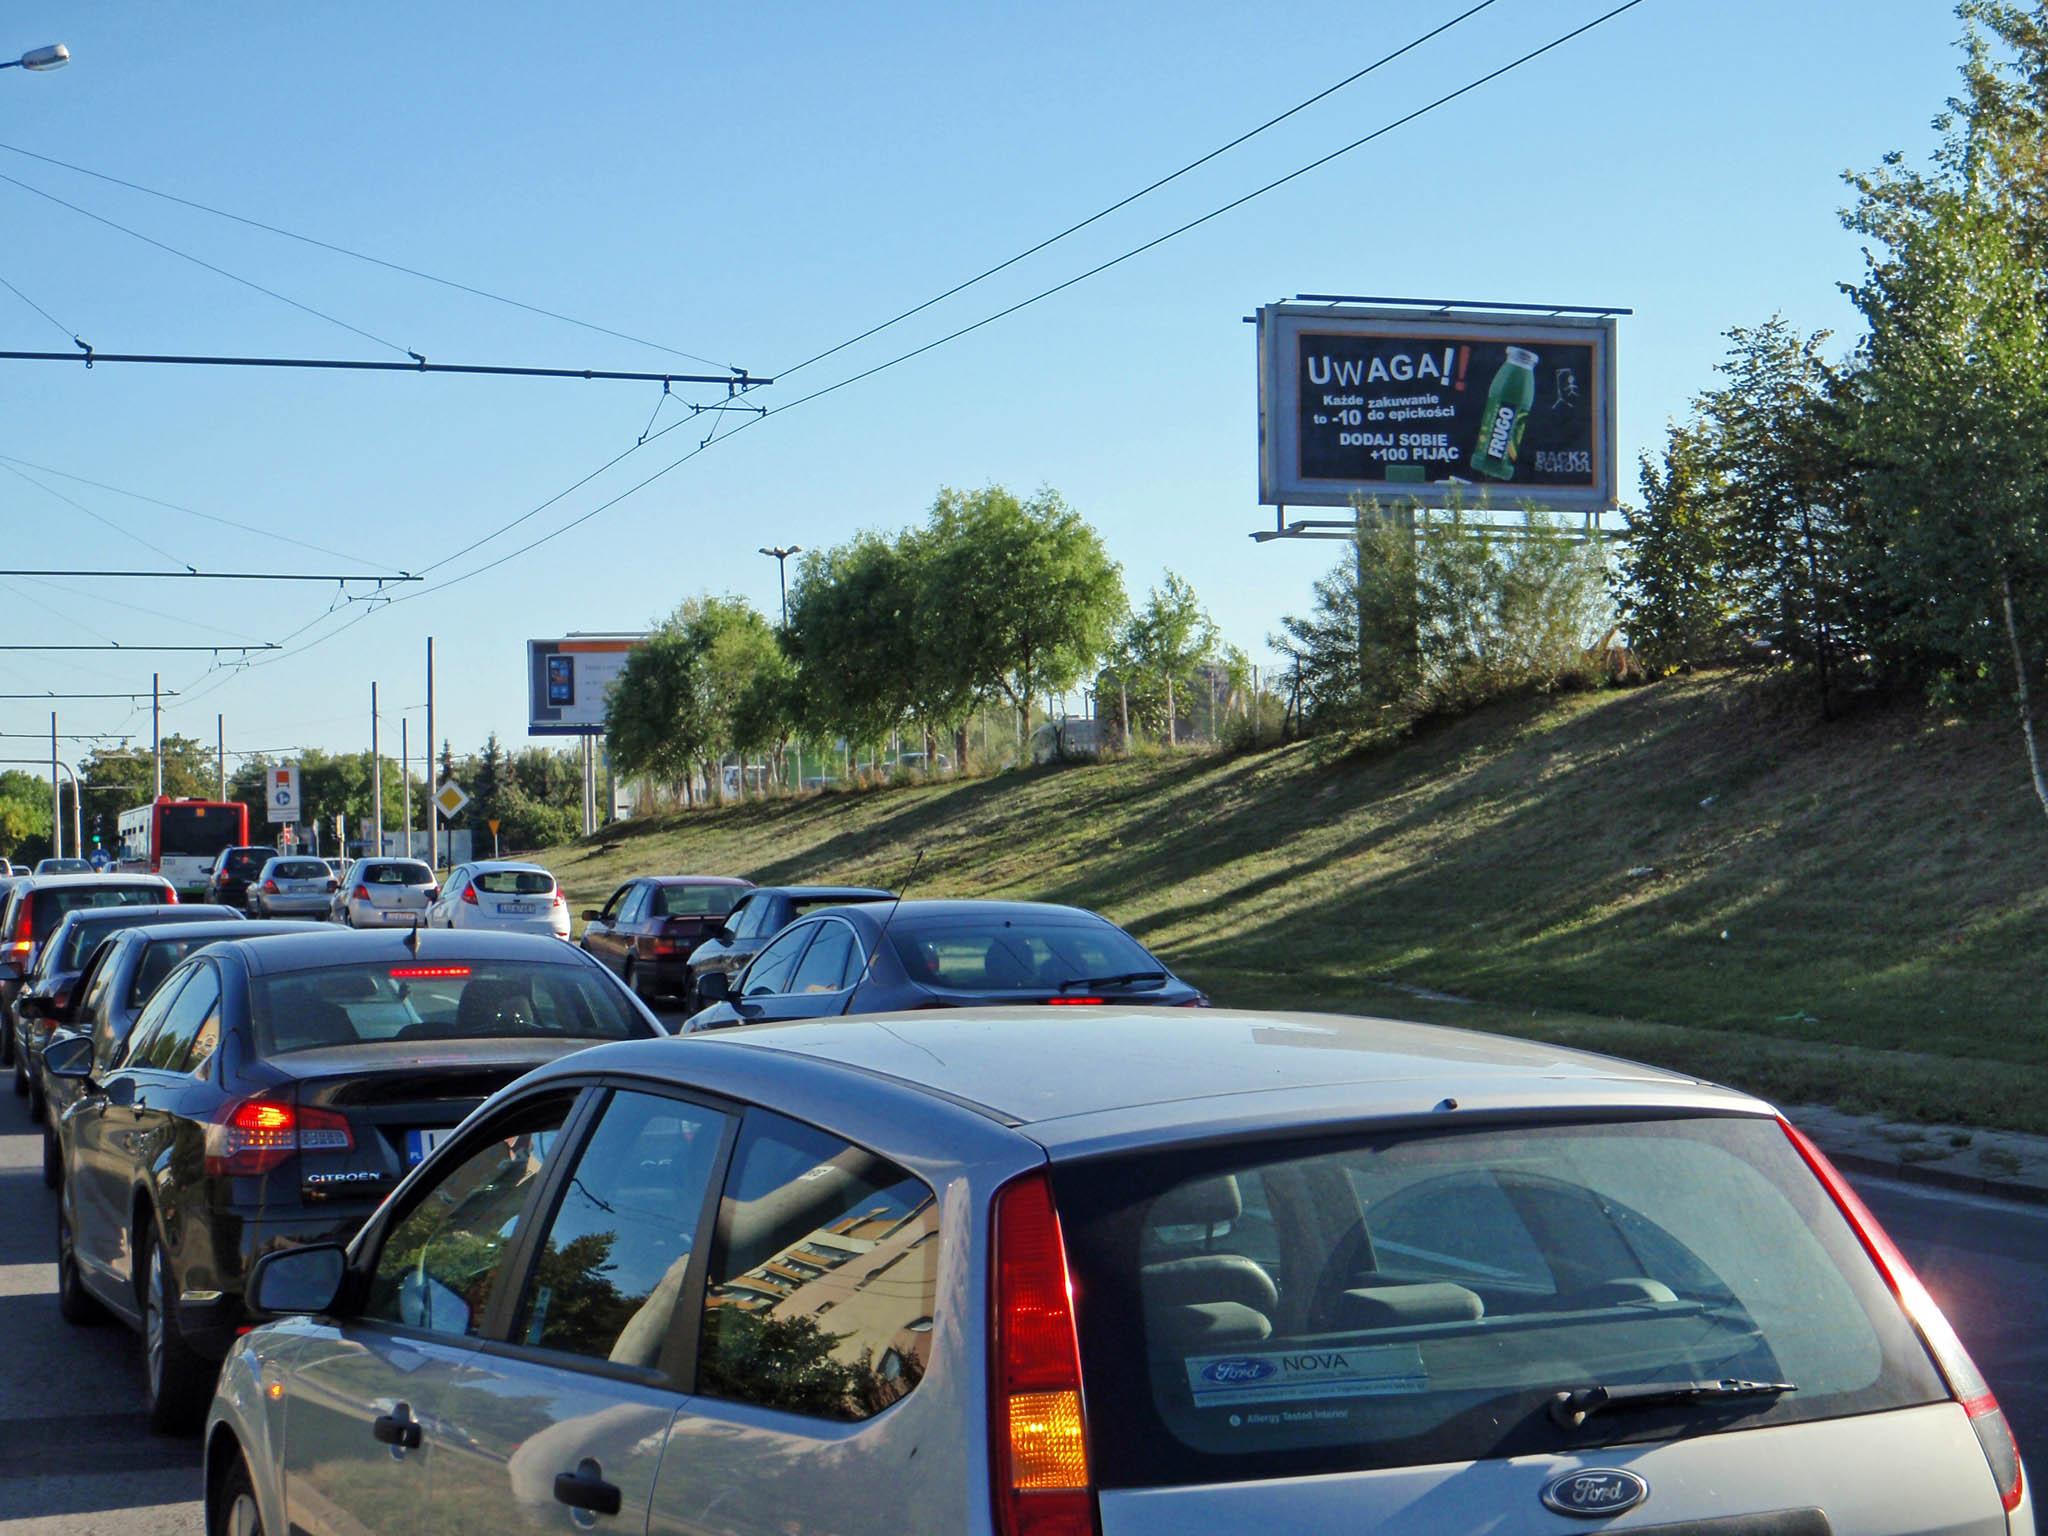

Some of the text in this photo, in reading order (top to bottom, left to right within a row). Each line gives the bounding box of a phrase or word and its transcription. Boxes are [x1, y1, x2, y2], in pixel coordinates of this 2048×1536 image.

[1323, 393, 1440, 409] Każde zakuwanie
[1313, 405, 1455, 426] to -10 do epickości
[1339, 432, 1448, 447] DODAJ SOBIE
[1487, 406, 1515, 460] FRUGO
[1370, 446, 1459, 463] +100 PIJĄC
[1534, 461, 1593, 474] SCHOOL
[1215, 1353, 1349, 1381] Ford NOVA
[1571, 1476, 1624, 1504] Ford
